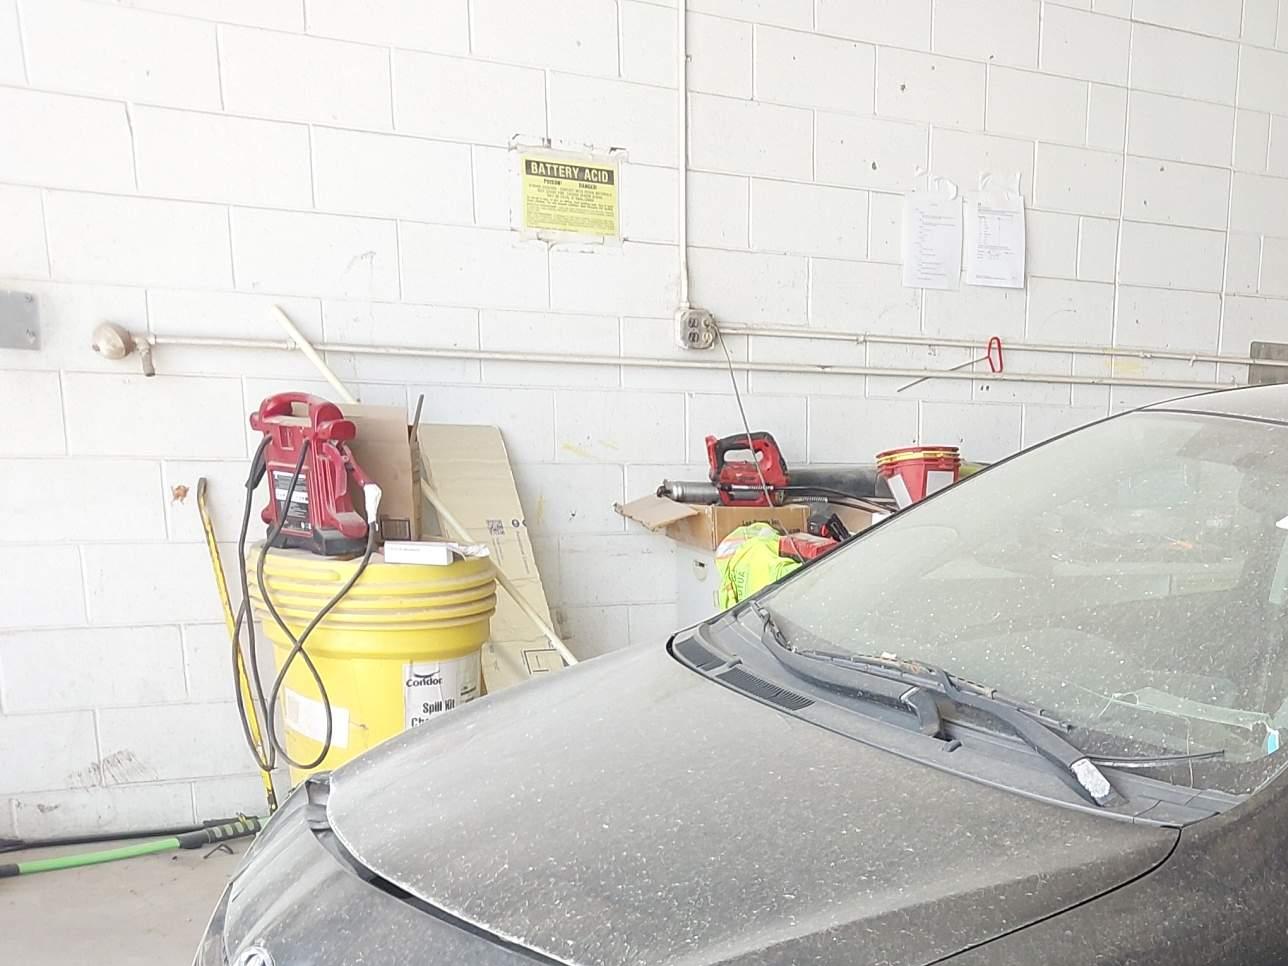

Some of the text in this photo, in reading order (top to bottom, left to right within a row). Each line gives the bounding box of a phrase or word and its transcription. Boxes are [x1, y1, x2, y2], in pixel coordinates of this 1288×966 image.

[531, 162, 609, 183] BATTERY ACID
[406, 677, 443, 688] Condor
[422, 698, 456, 715] Spill Kit
